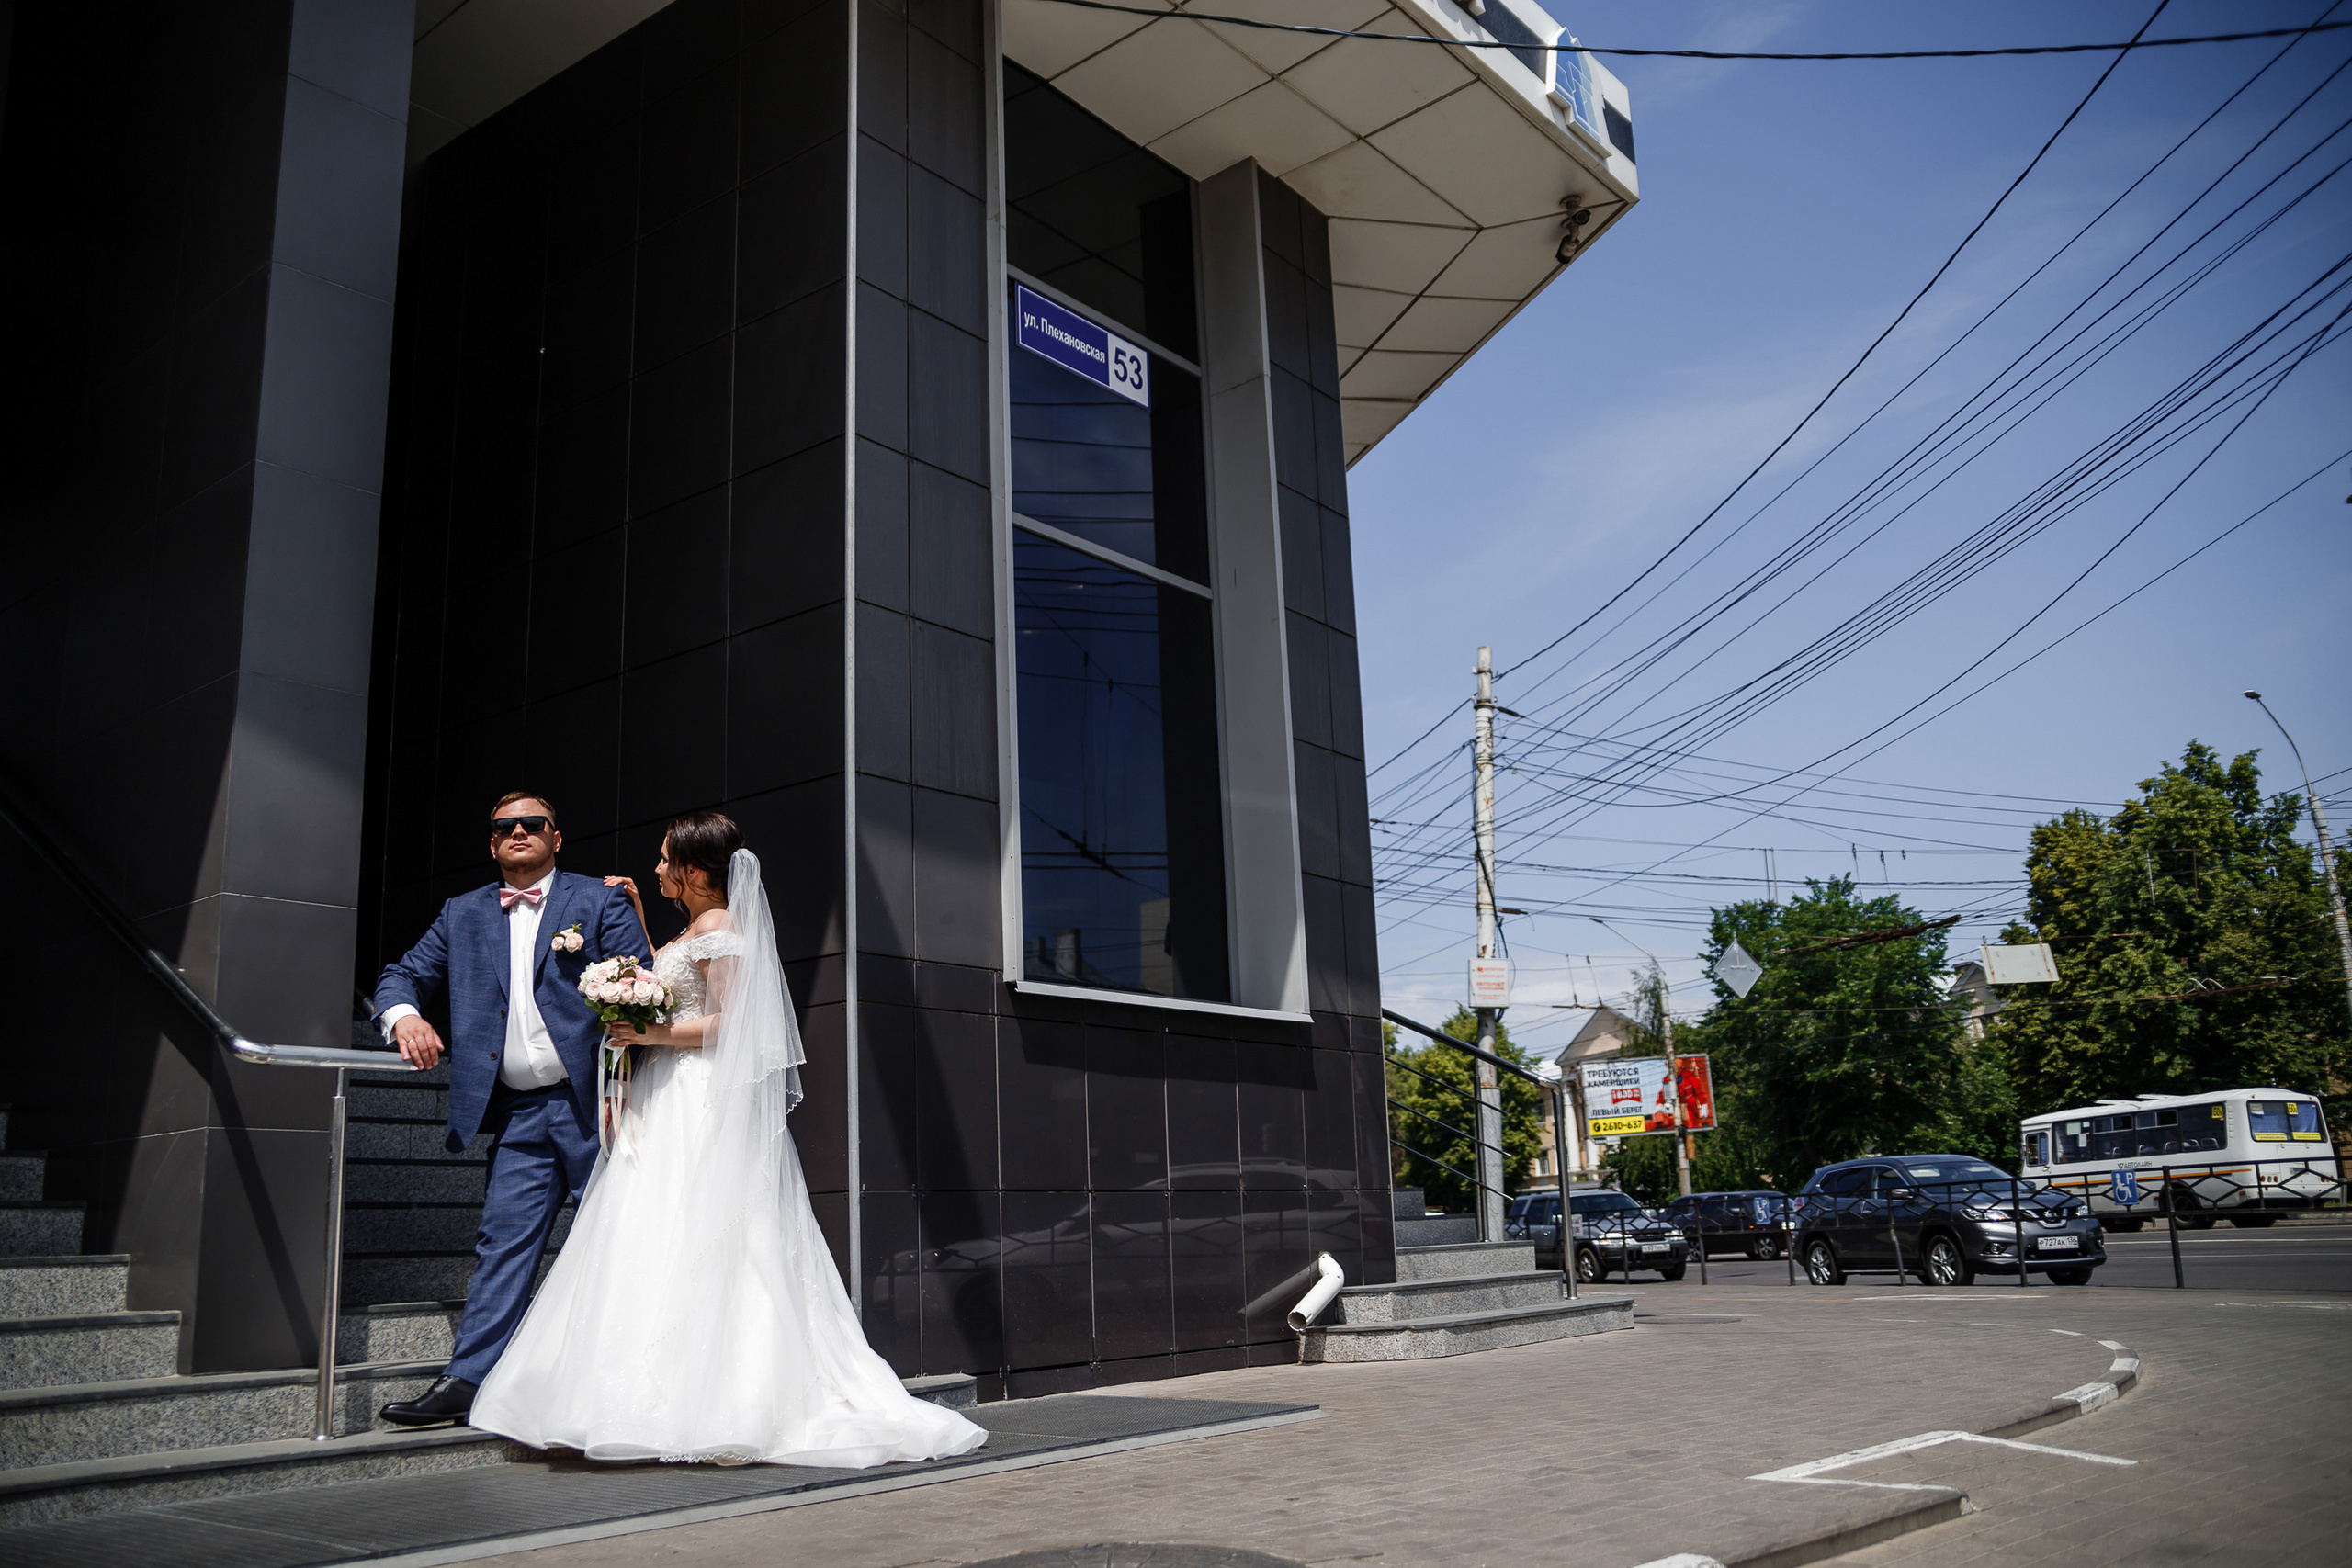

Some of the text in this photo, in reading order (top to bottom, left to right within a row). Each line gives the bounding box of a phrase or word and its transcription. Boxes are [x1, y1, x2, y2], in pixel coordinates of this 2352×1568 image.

[1023, 311, 1144, 390] ул. Плехановская 53
[1588, 1067, 1639, 1077] ТРЕБУЮТСЯ
[1588, 1078, 1640, 1087] КАМЕНЩИКИ
[1592, 1105, 1643, 1116] ЛЕВЫЙ БЕРЕГ
[1602, 1120, 1643, 1131] 2610-637
[2125, 1172, 2133, 1185] P
[1761, 1199, 1768, 1209] P
